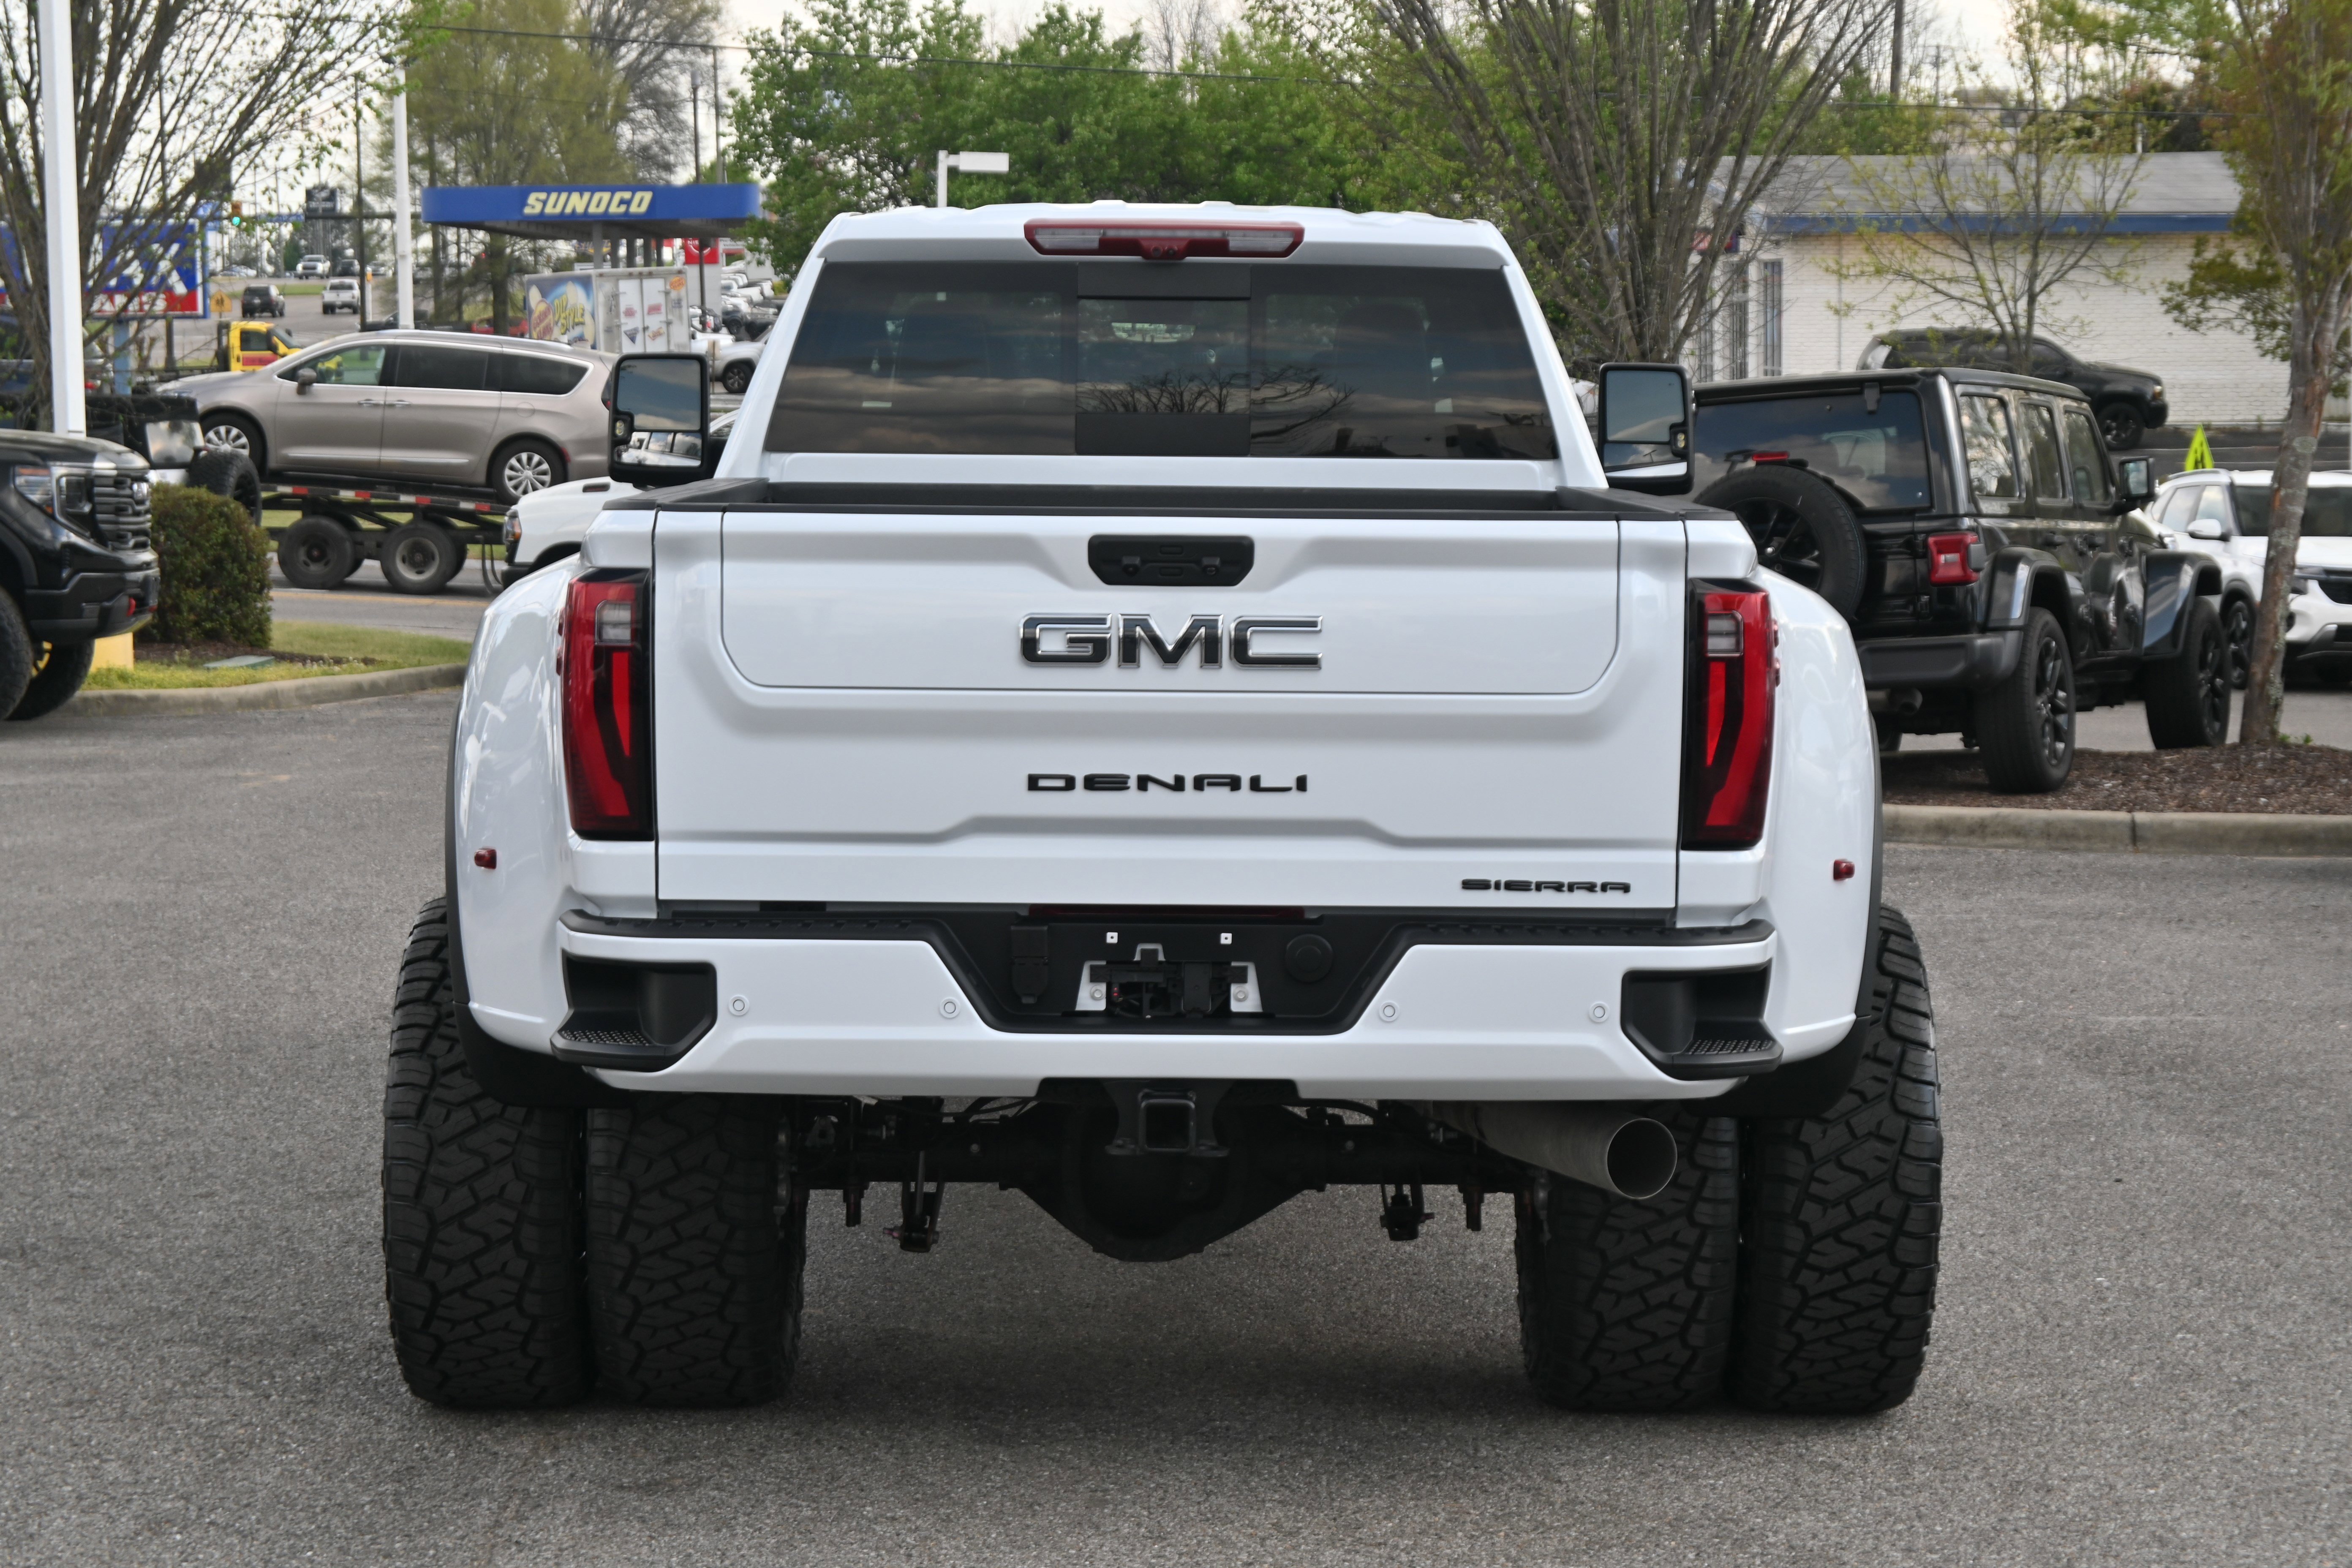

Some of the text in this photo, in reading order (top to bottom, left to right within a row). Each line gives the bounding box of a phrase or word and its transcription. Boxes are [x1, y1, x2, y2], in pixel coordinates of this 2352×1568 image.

[523, 191, 653, 214] SUNOCO
[554, 294, 568, 325] DIP
[561, 303, 585, 335] STYLE
[1019, 612, 1323, 670] GMC
[1027, 773, 1308, 792] DENALI
[1461, 878, 1631, 893] SIERRA
